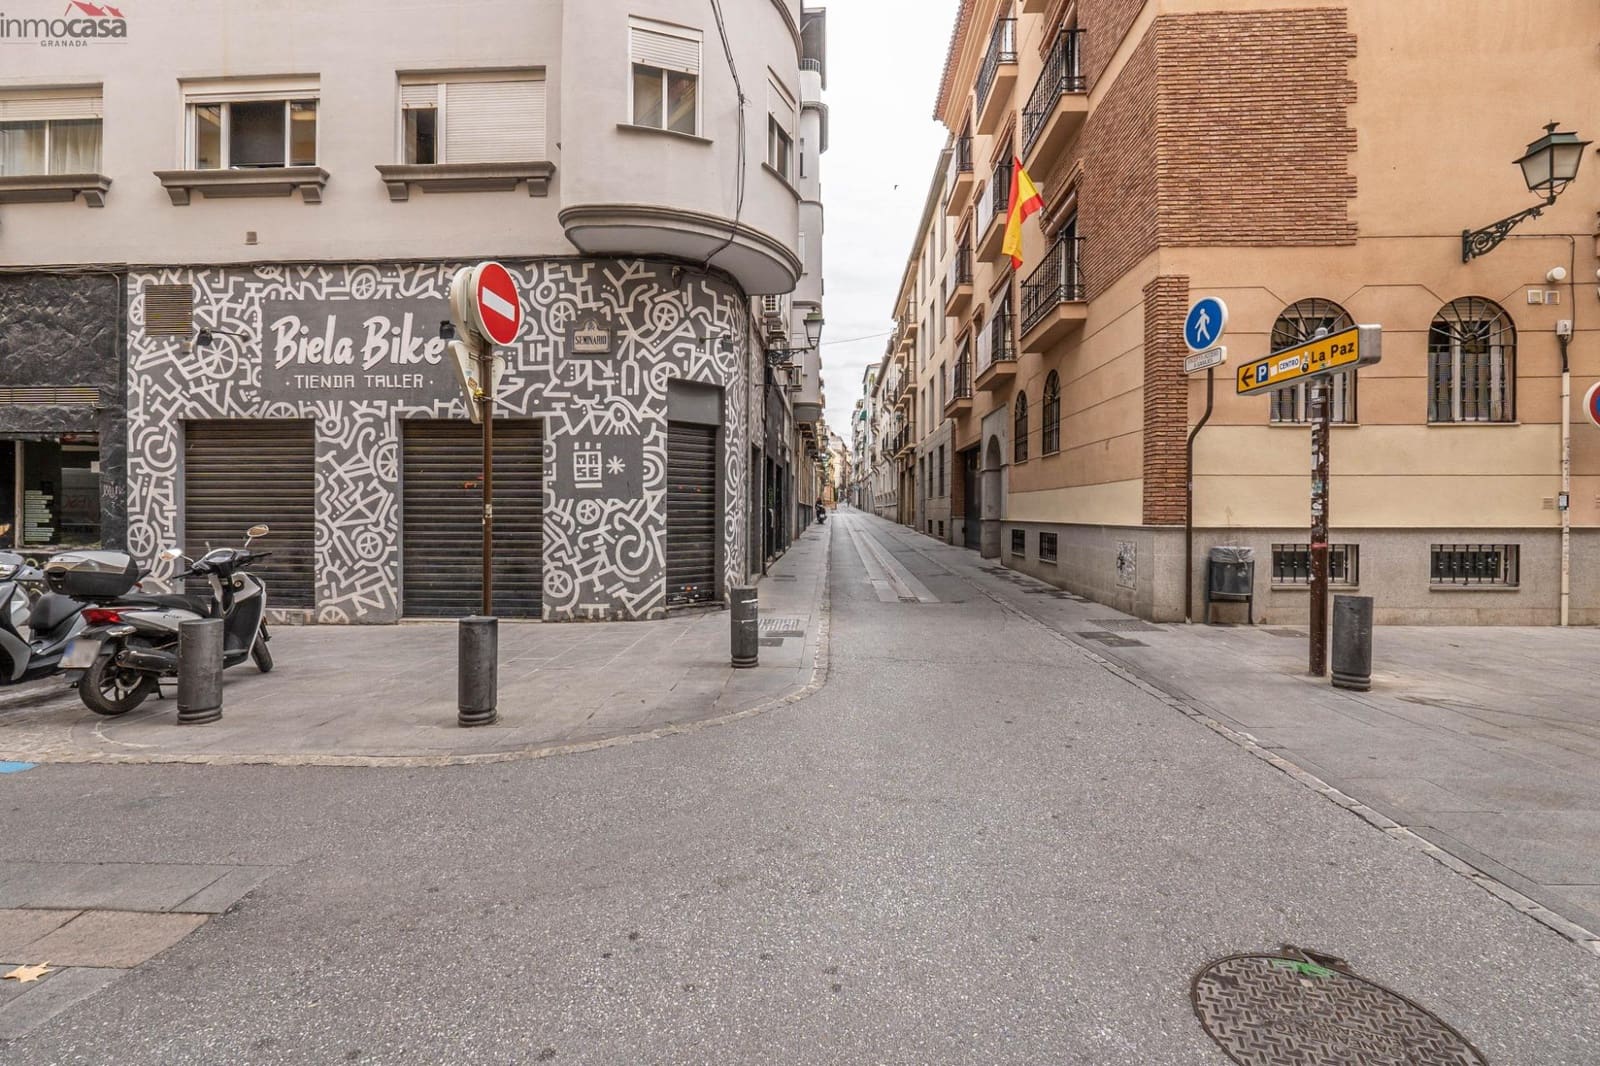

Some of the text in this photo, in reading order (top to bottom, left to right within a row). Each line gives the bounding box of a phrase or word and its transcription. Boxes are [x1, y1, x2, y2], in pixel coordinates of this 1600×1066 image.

[270, 312, 446, 371] Biela Bike
[294, 374, 424, 389] TIENDA TALLER
[1257, 342, 1355, 382] P CENTRO La Paz
